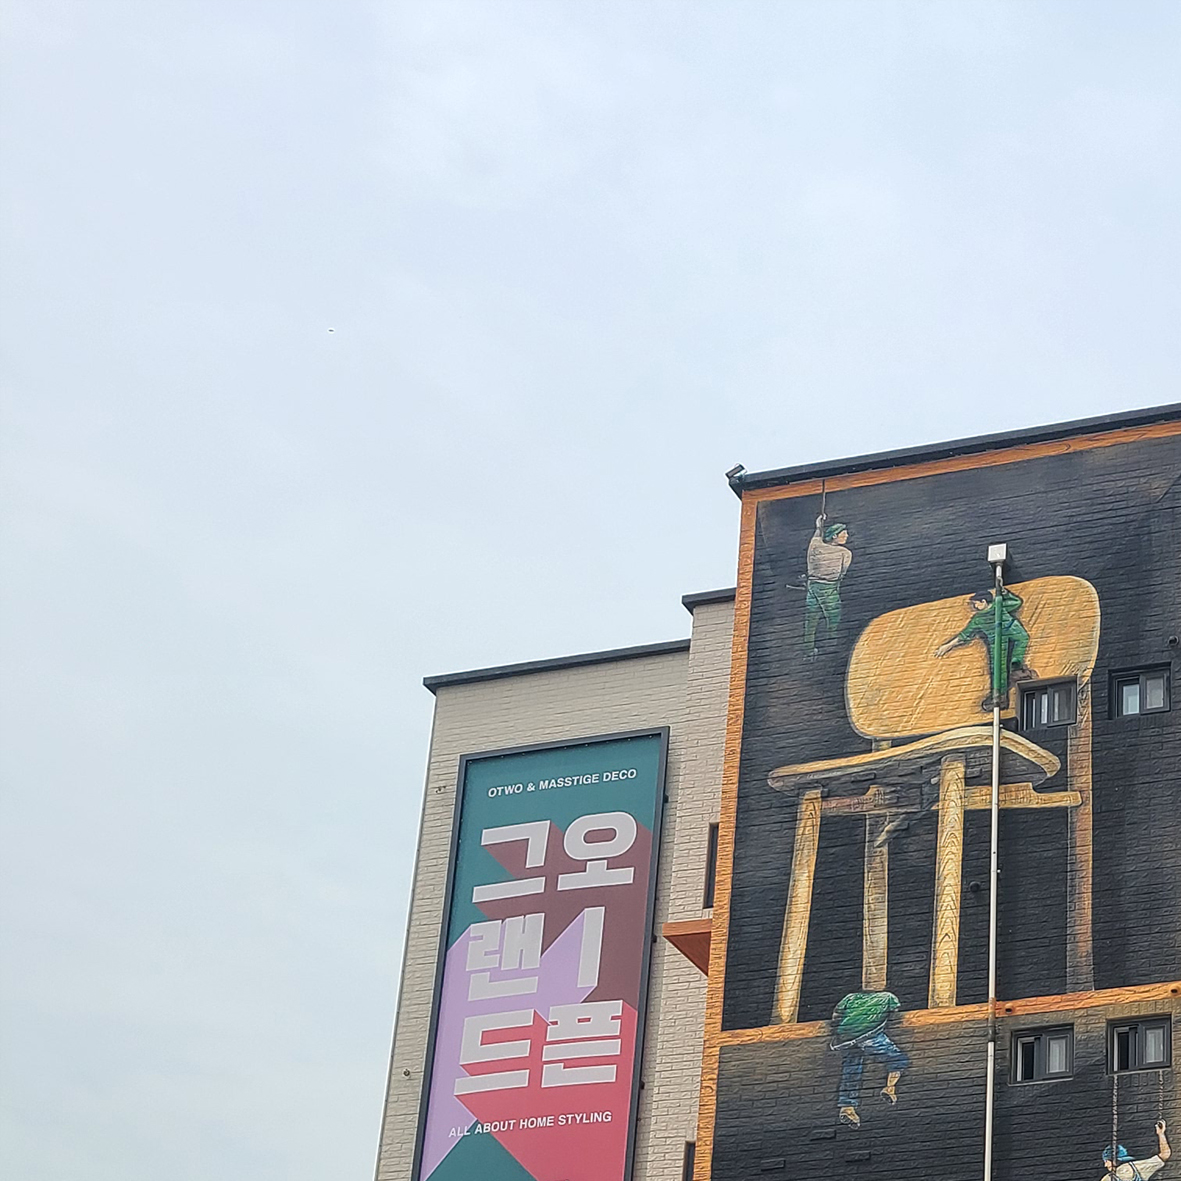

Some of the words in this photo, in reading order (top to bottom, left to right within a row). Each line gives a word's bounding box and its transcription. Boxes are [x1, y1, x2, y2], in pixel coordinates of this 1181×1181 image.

[488, 784, 523, 797] OTWO
[527, 783, 536, 792] &
[539, 774, 600, 790] MASSTIGE
[603, 769, 637, 782] DECO
[448, 1127, 471, 1138] ALL
[474, 1120, 516, 1134] ABOUT
[519, 1116, 554, 1129] HOME
[558, 1111, 612, 1126] STYLING
